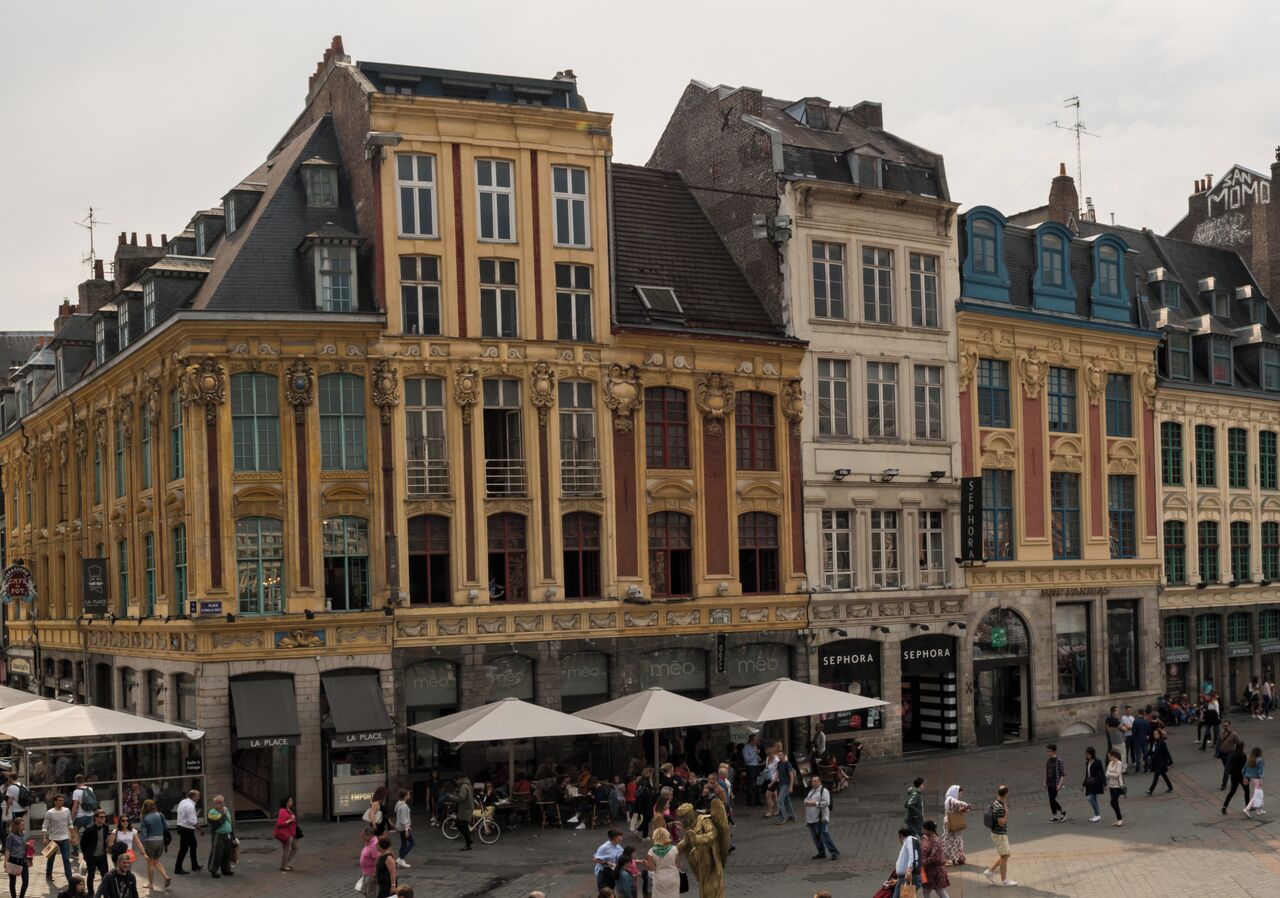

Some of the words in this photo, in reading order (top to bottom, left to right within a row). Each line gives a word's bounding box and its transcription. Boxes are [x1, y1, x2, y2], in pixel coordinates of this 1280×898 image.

[1222, 169, 1252, 187] SAN
[1207, 180, 1271, 217] MOMO
[1066, 587, 1111, 596] PARIBAS
[823, 654, 874, 666] SEPHORA
[903, 648, 951, 660] SEPHORA
[264, 738, 289, 746] PLACE
[360, 732, 383, 741] PLACE
